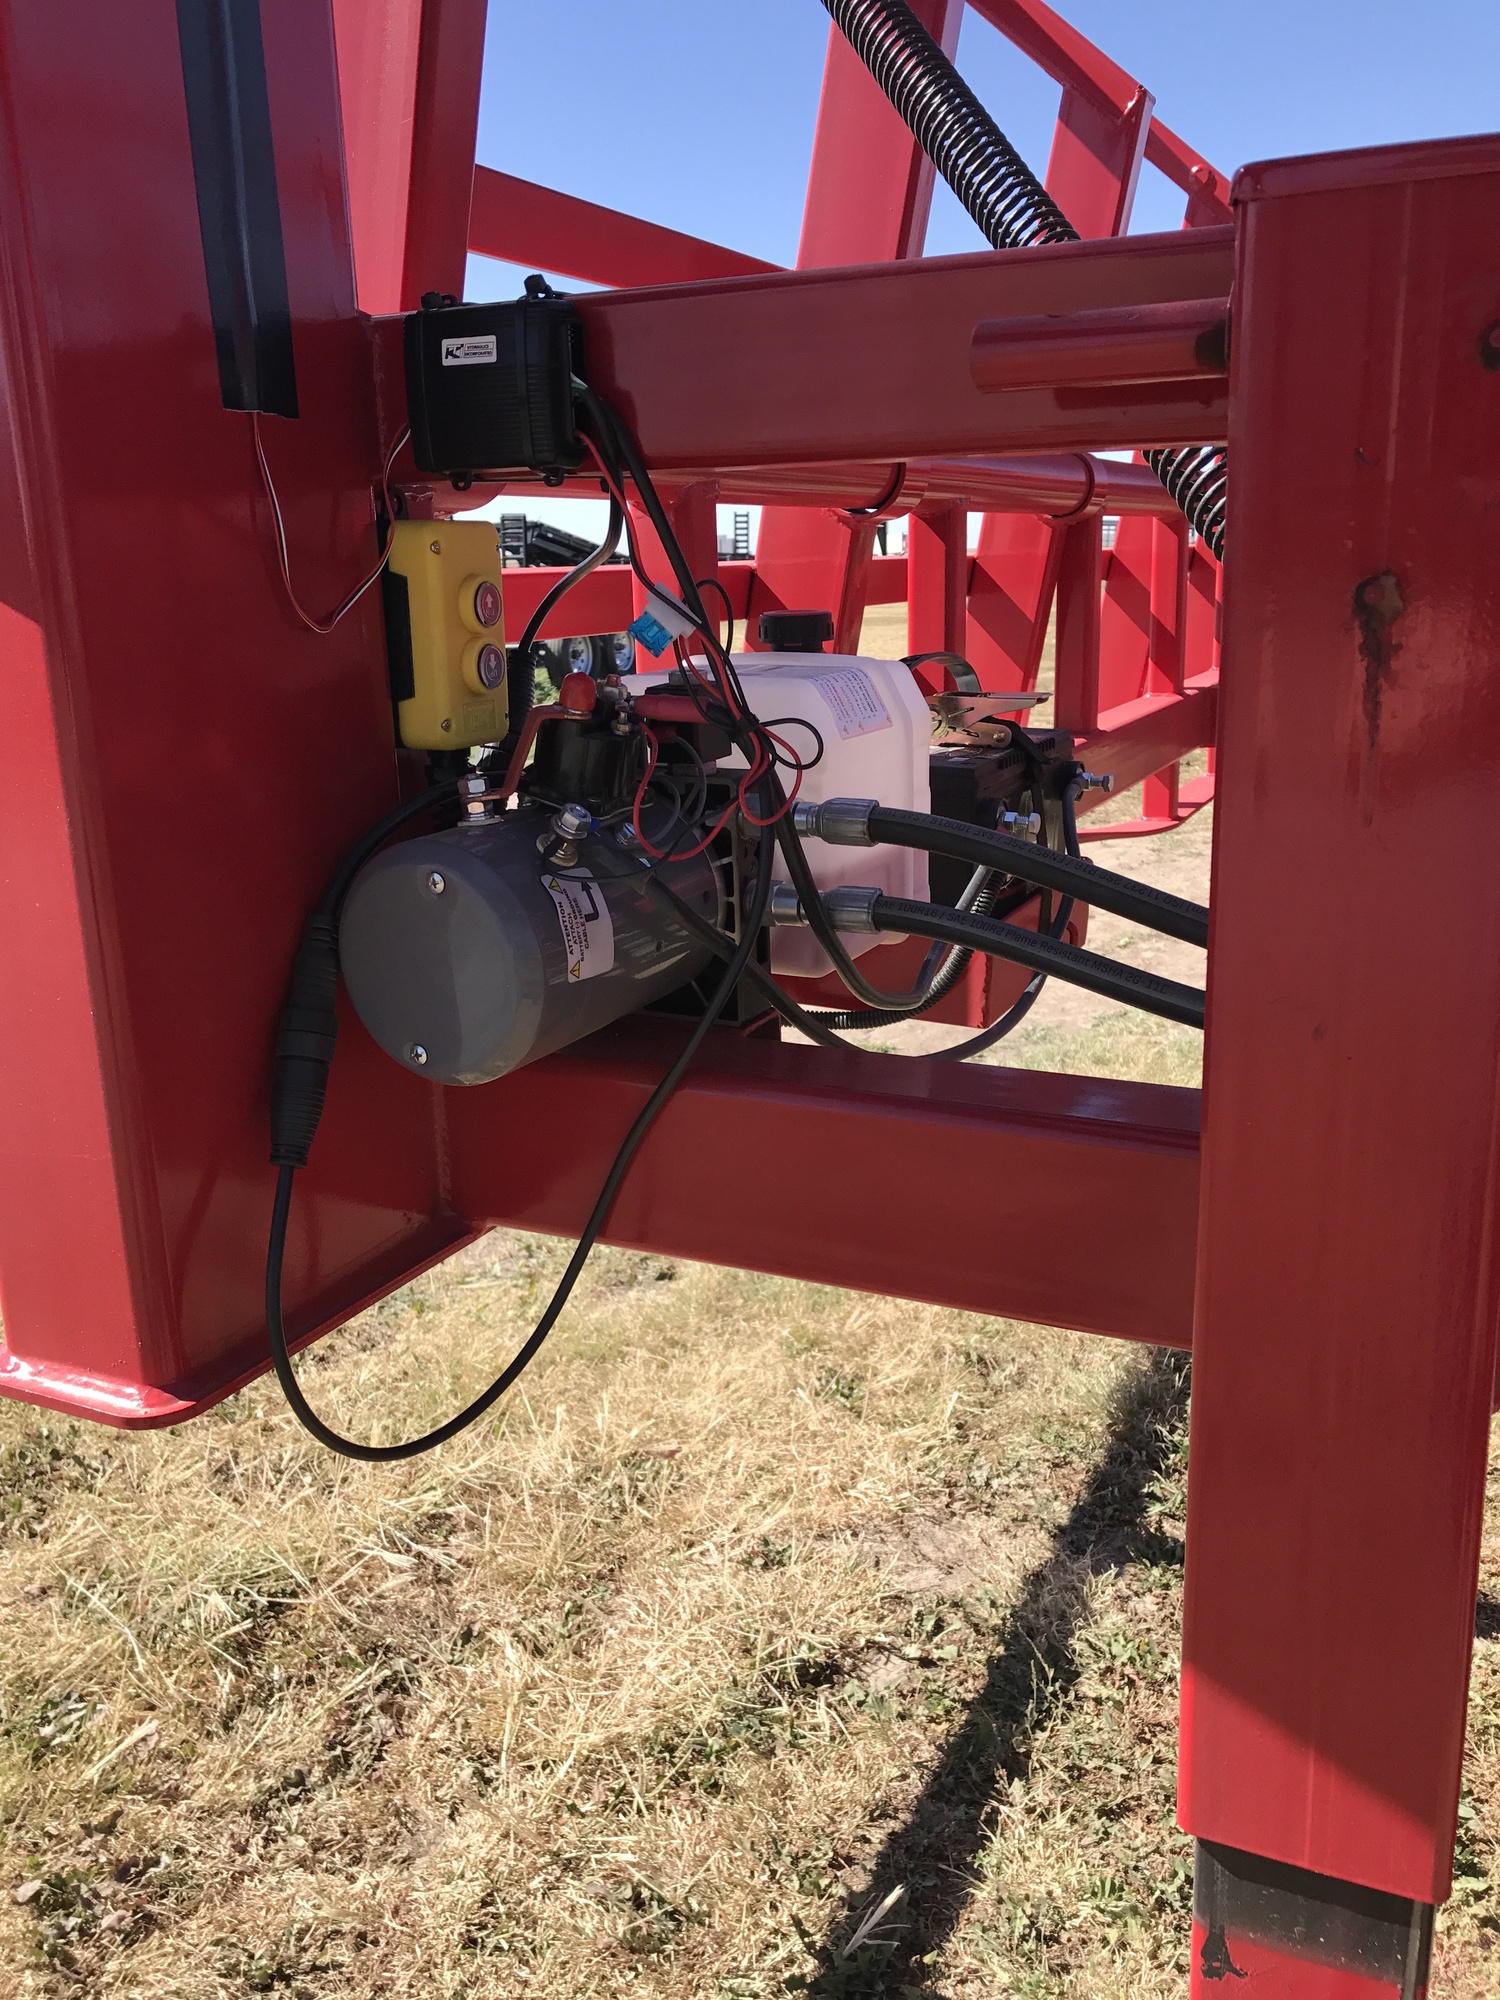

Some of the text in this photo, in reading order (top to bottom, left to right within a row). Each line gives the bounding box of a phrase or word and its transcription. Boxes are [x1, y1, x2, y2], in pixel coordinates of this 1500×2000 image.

[900, 811, 922, 822] SAE
[930, 816, 971, 834] 100R16
[973, 828, 996, 841] SAE
[1028, 844, 1067, 864] EN857
[1074, 863, 1098, 877] R16
[562, 887, 578, 920] GROUND
[557, 901, 574, 956] ATTENTION
[567, 912, 579, 945] ATTACH
[572, 897, 590, 949] CABLE HERE
[576, 931, 585, 962] BATTERY
[875, 900, 896, 910] SAE
[898, 902, 938, 918] 100R16
[945, 912, 969, 925] SAE
[969, 917, 1005, 936] 100R2
[1005, 930, 1037, 948] Flame
[1039, 941, 1091, 967] Resistant
[1091, 960, 1124, 979] MSHA
